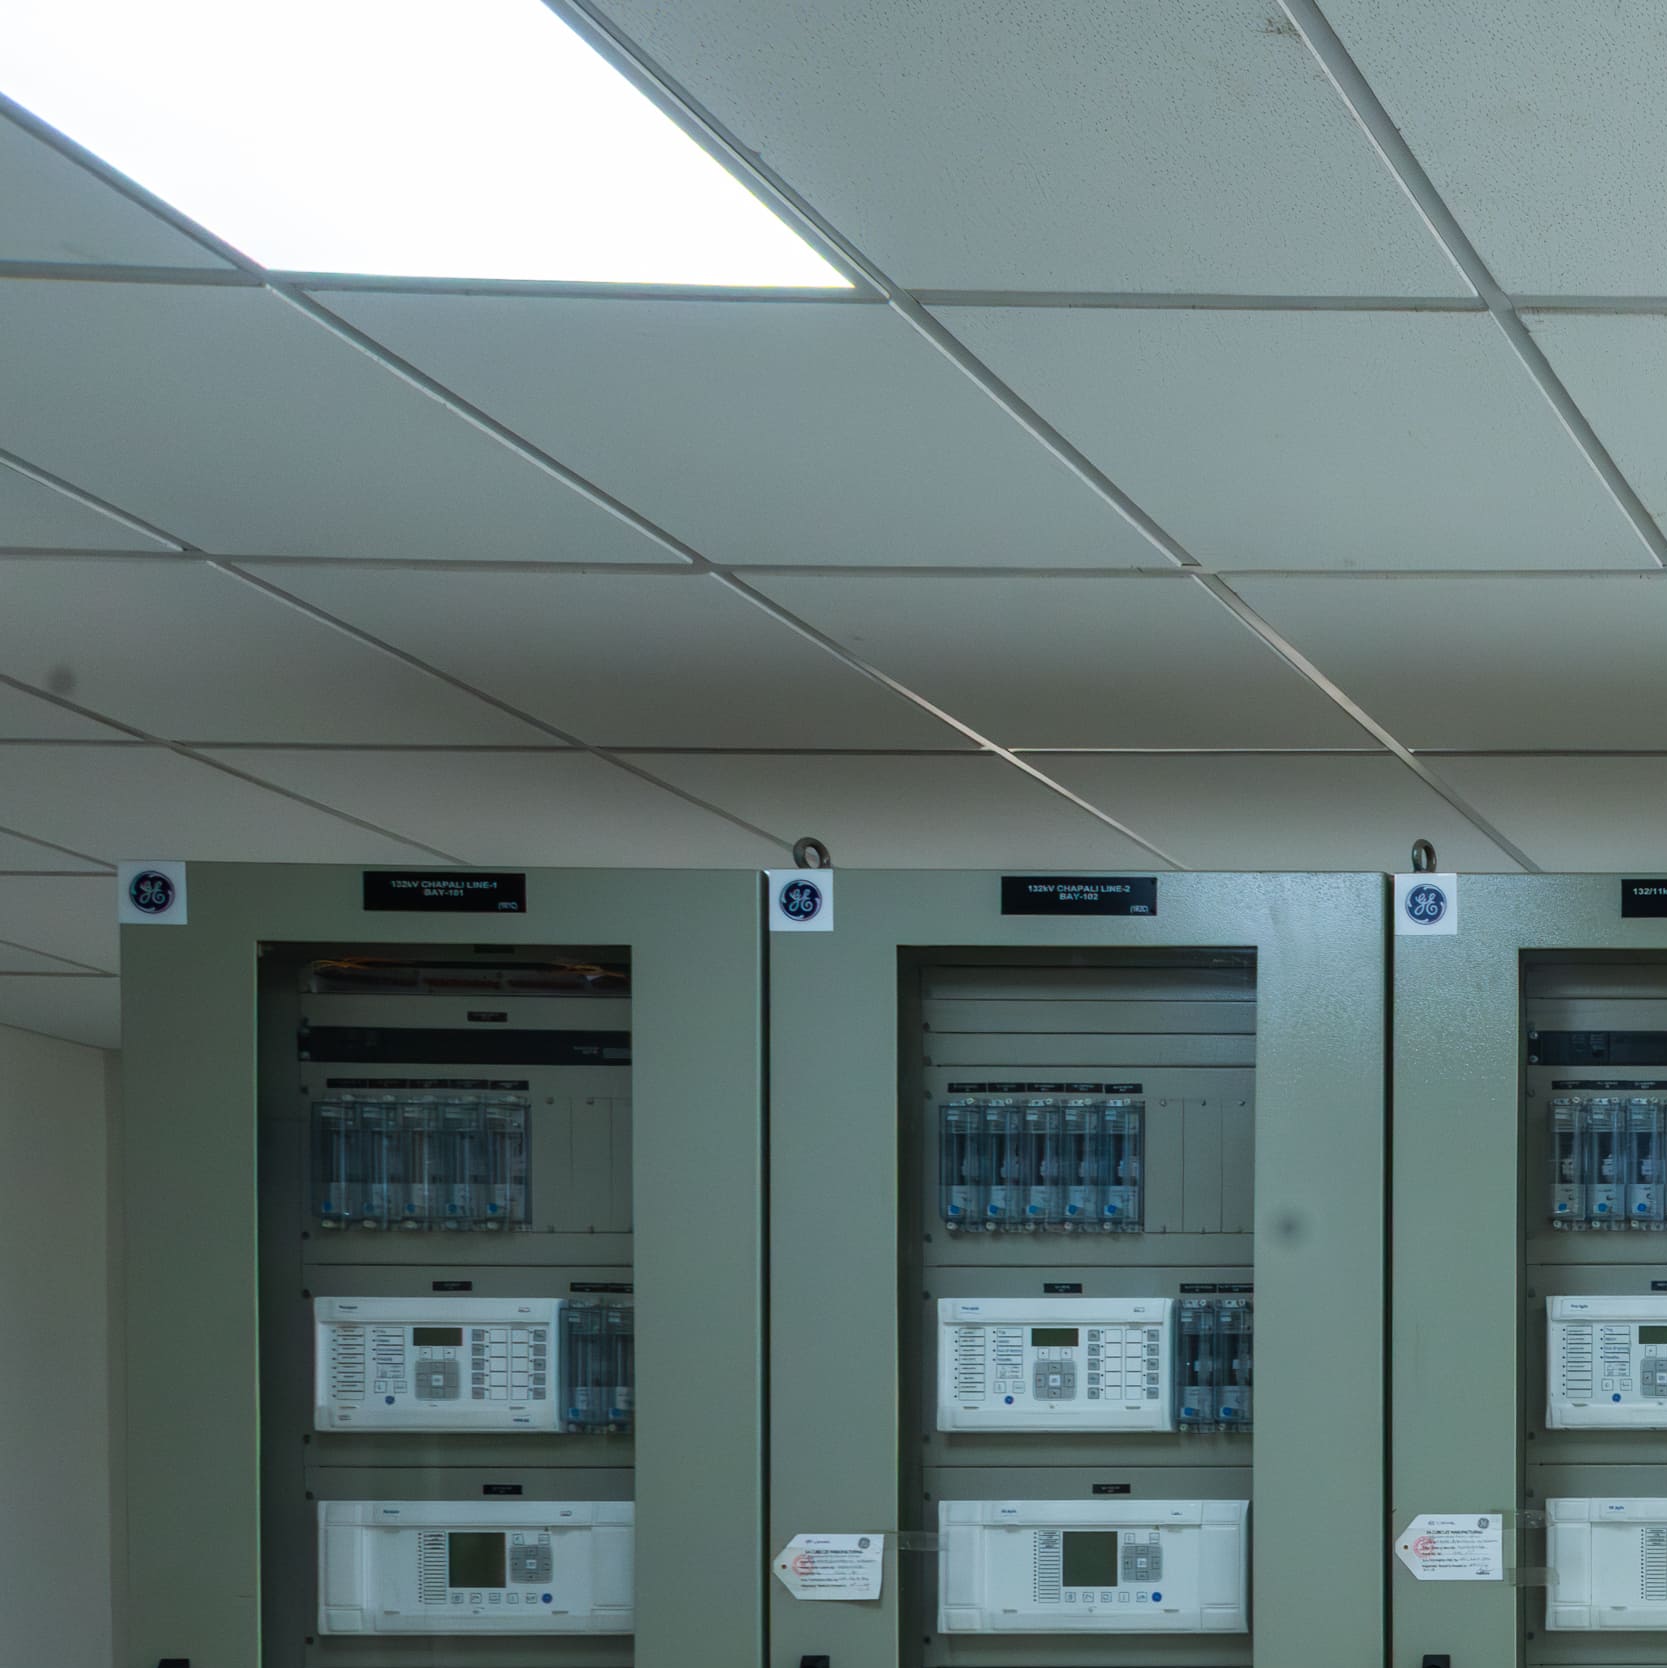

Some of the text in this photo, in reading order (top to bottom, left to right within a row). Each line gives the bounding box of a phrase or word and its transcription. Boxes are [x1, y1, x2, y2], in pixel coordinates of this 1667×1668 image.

[421, 881, 464, 889] CHAPALI
[467, 881, 497, 889] LINE-1
[1028, 885, 1131, 893] 132kV CHAPALI LINE-2
